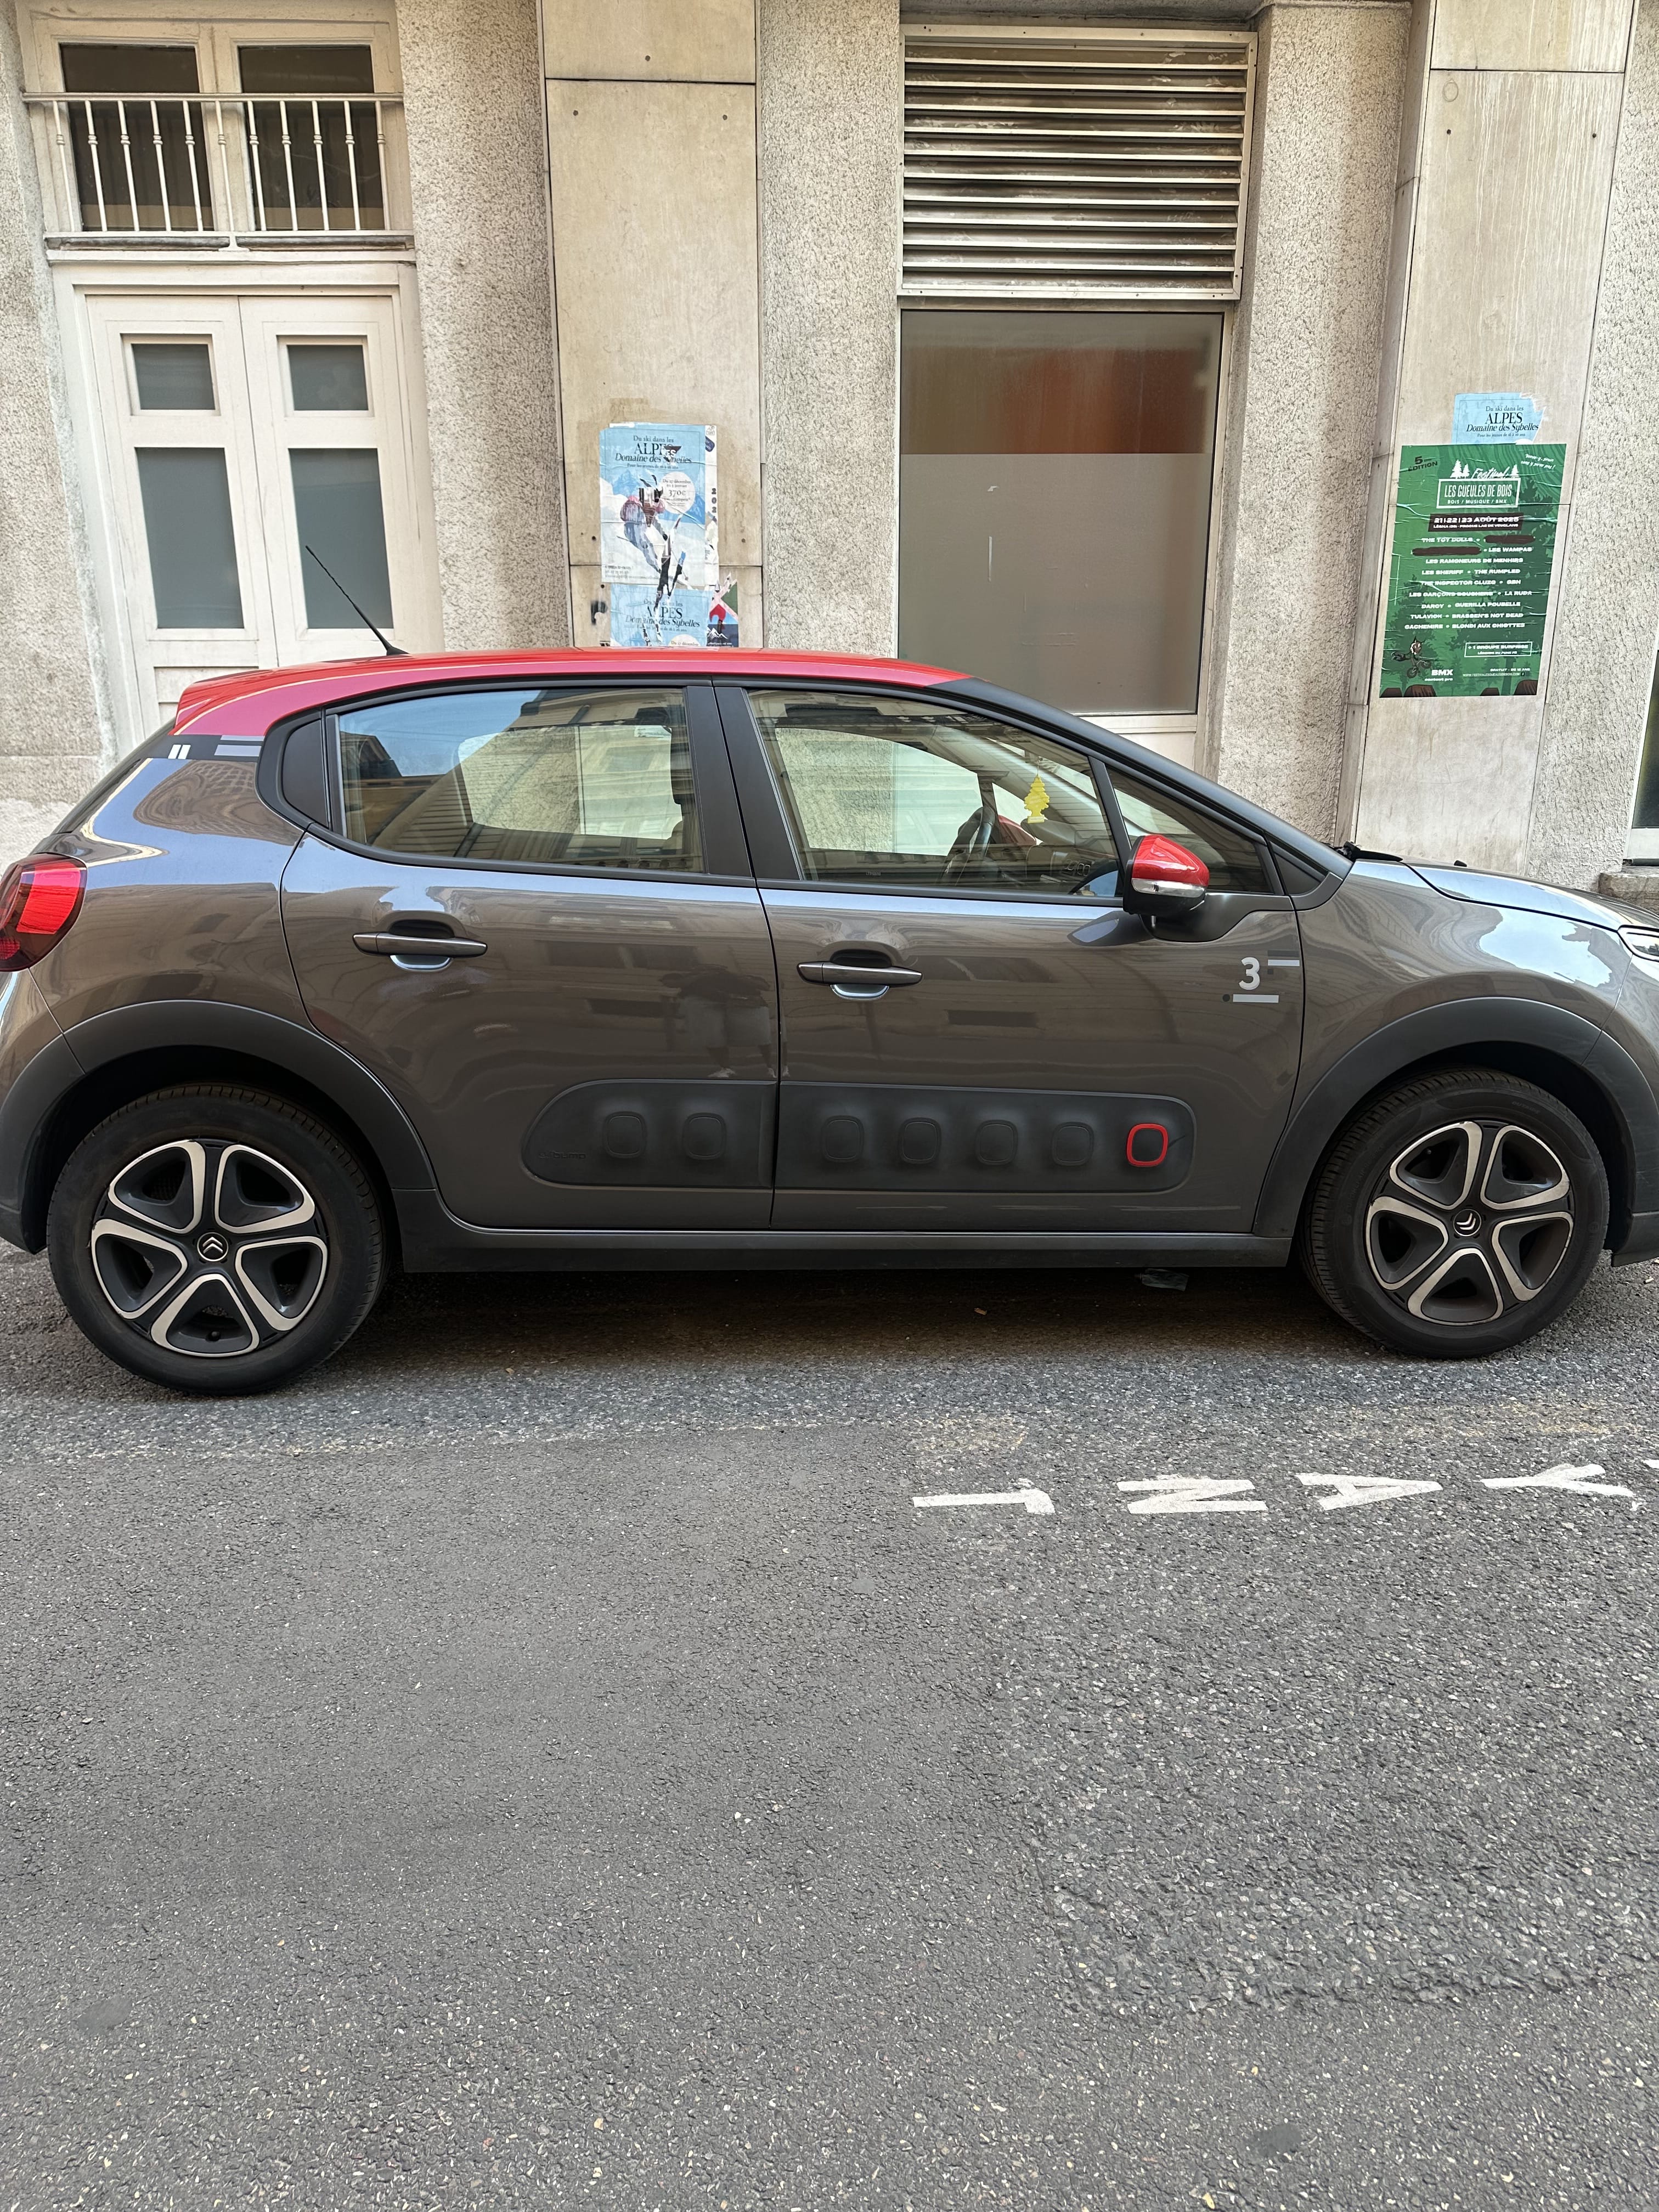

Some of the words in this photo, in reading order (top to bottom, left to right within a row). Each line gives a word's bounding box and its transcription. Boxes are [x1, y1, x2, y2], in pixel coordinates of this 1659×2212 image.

[1485, 412, 1523, 424] ALPES
[1511, 423, 1539, 432] Sybelles
[634, 443, 673, 455] ALP
[615, 453, 648, 462] Domaine
[649, 454, 662, 462] des
[1408, 461, 1438, 472] ÉDITION
[1444, 484, 1456, 498] LES
[1457, 484, 1486, 498] GUEULES
[1487, 484, 1496, 497] DE
[1497, 484, 1513, 497] BOIS
[672, 618, 701, 628] Sybelles
[1239, 957, 1260, 990] 3
